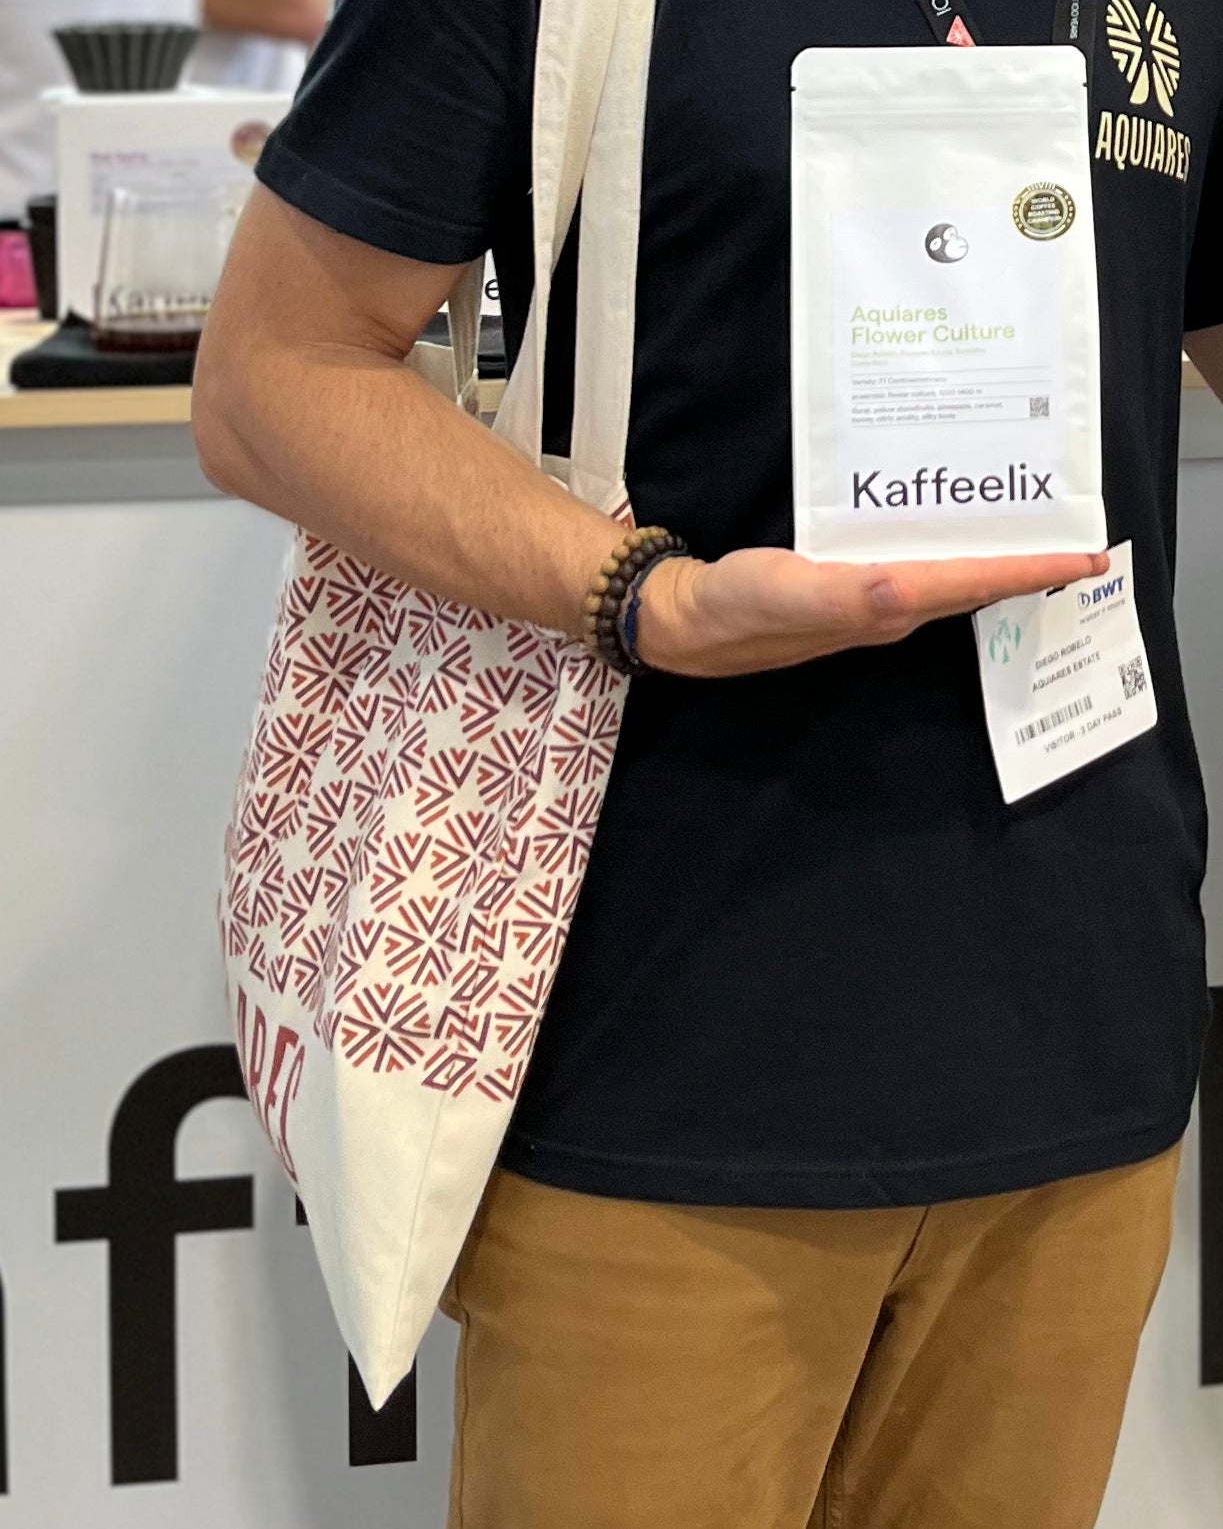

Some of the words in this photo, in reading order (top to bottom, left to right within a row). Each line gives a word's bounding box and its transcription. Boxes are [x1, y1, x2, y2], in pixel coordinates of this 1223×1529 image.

[1095, 111, 1191, 182] AQUIARES
[850, 305, 948, 327] Aquiares
[851, 326, 927, 345] Flower
[933, 323, 1016, 343] Culture
[853, 462, 1053, 509] Kaffeelix
[1093, 576, 1125, 604] BWT
[1035, 651, 1059, 670] DIEGO
[1061, 635, 1092, 657] ROBELO
